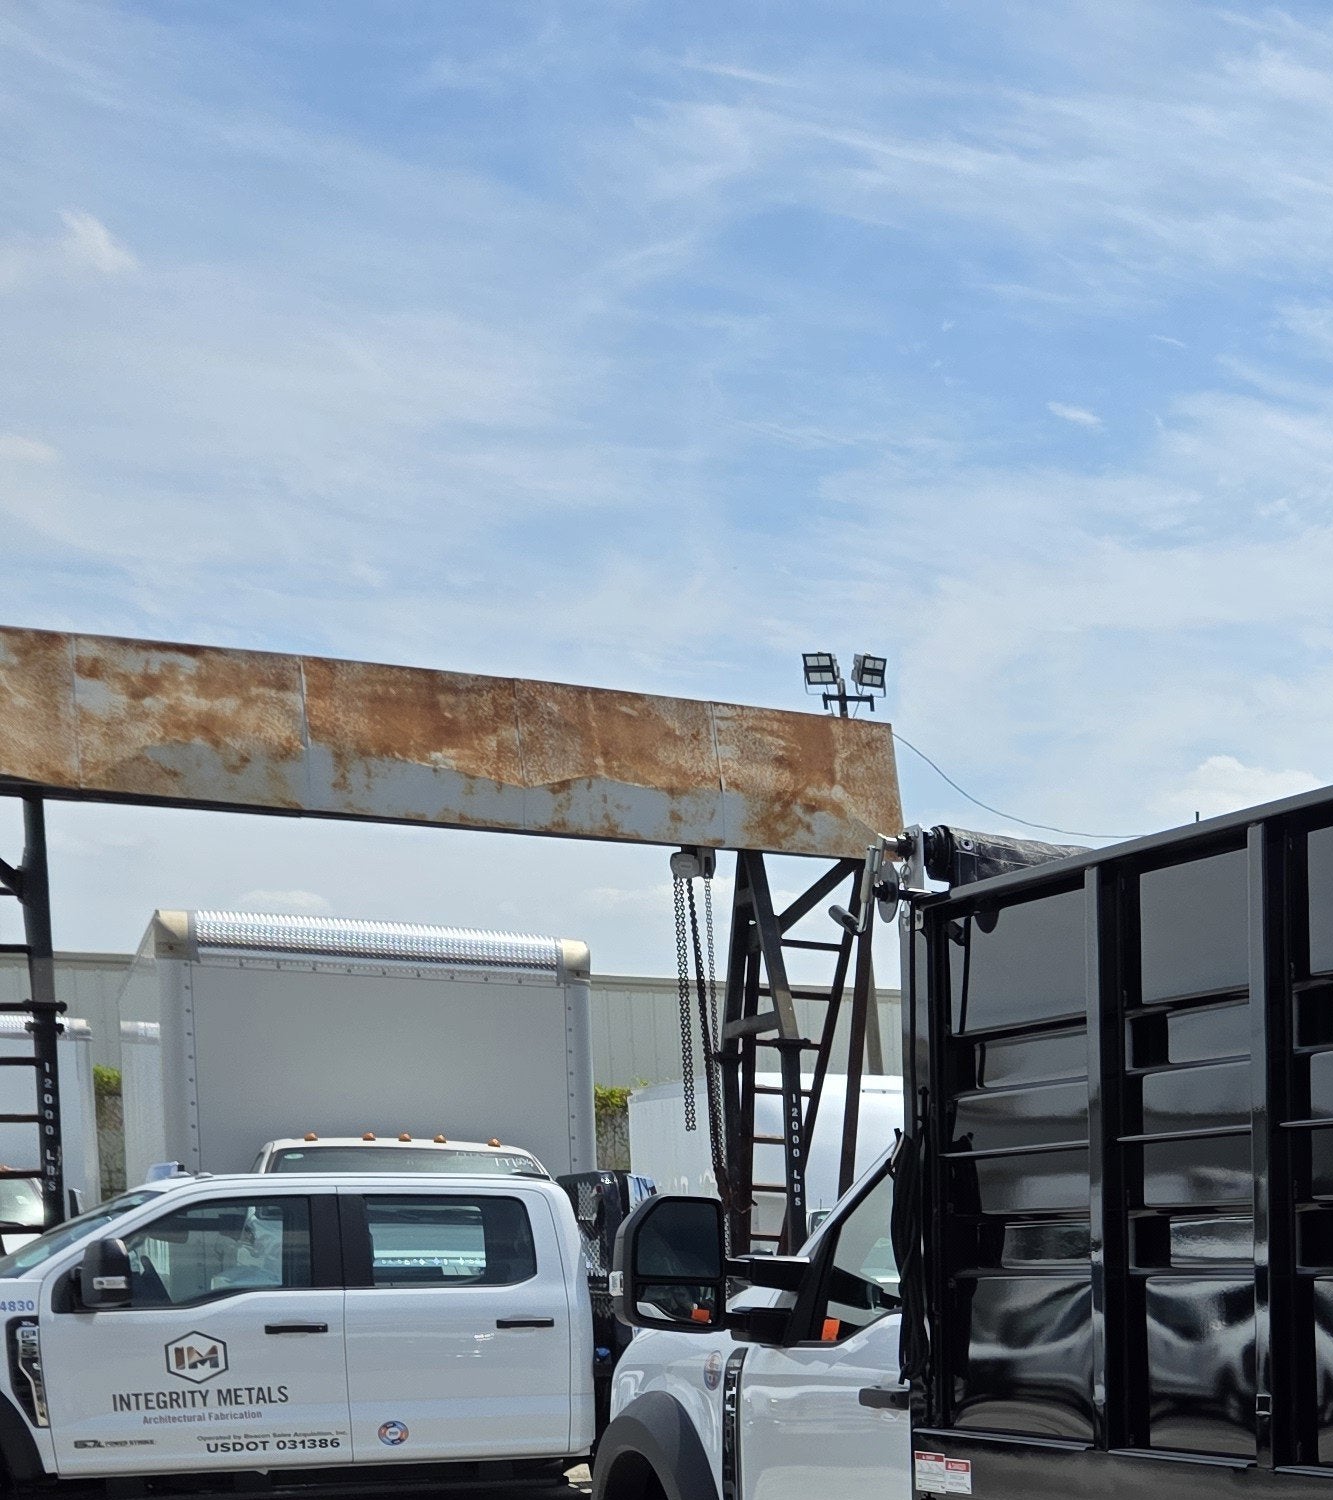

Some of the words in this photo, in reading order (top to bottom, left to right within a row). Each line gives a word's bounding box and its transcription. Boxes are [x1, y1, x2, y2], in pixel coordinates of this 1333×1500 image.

[43, 1062, 55, 1135] 12000
[46, 1149, 56, 1191] LBS
[112, 1389, 210, 1412] INTEGRITY
[217, 1385, 289, 1406] METALS
[142, 1412, 206, 1425] Architectural
[208, 1410, 263, 1421] Fabrication
[206, 1440, 270, 1453] USDOT
[276, 1438, 341, 1451] 031386
